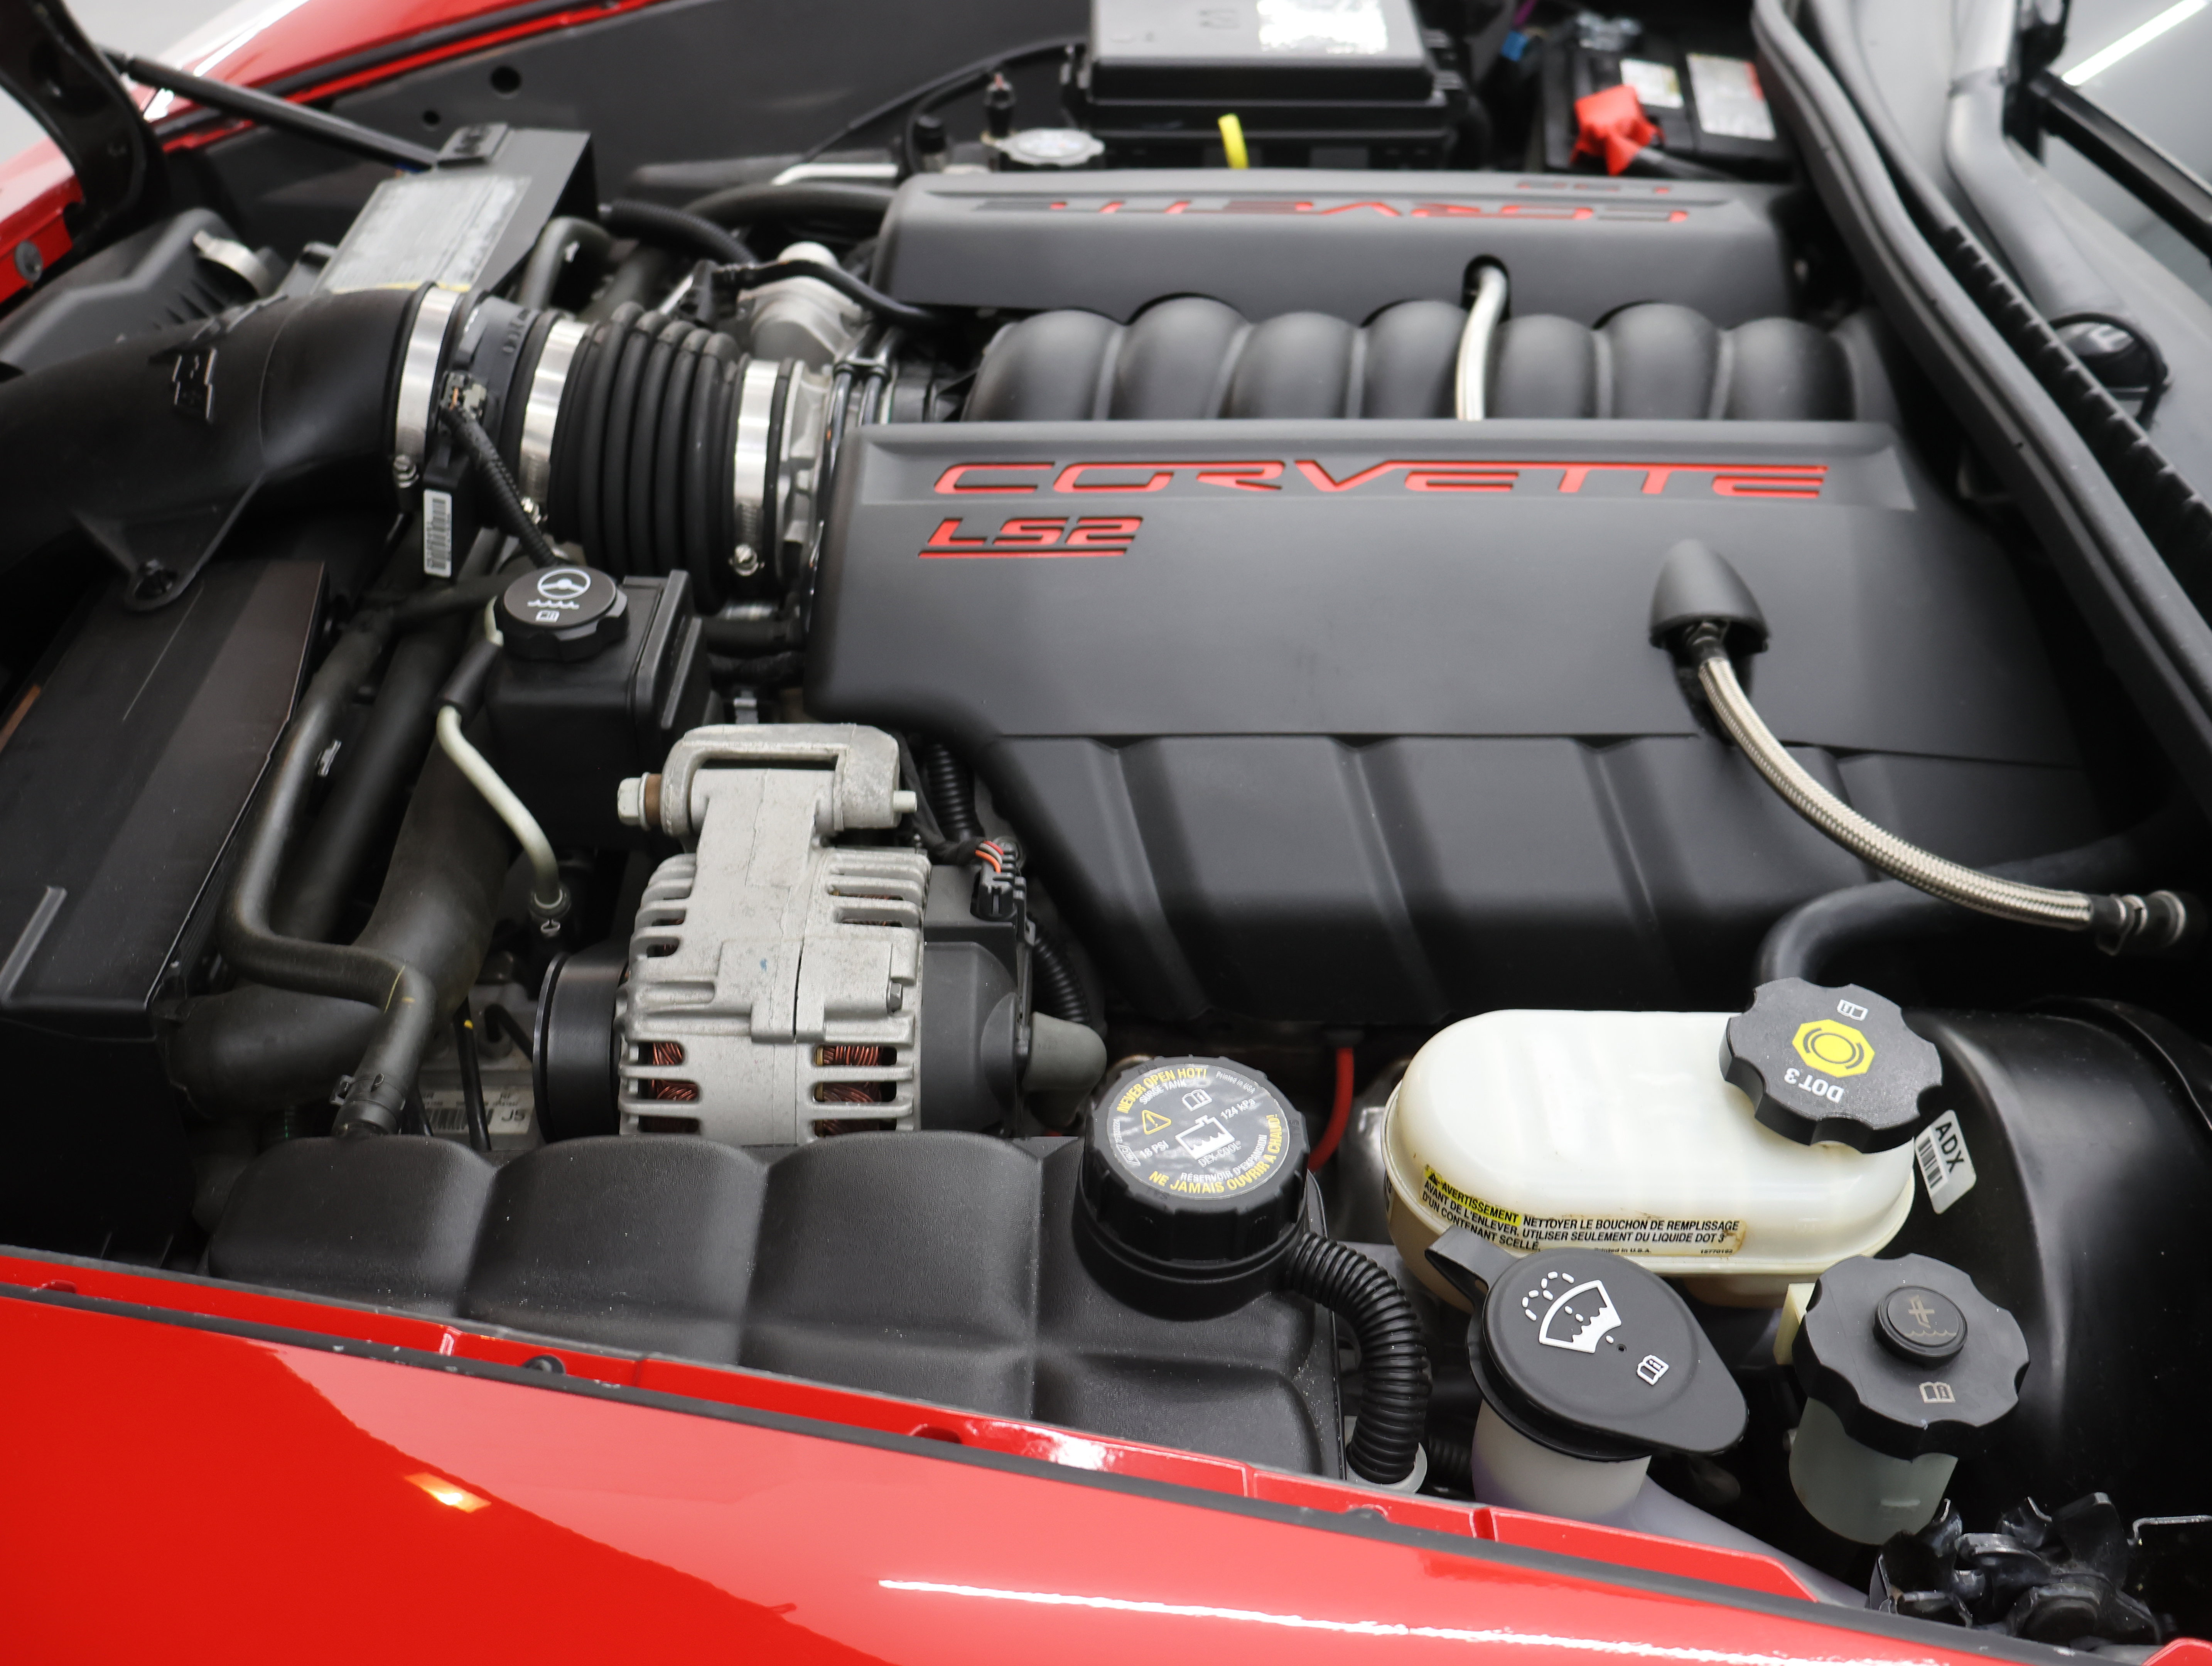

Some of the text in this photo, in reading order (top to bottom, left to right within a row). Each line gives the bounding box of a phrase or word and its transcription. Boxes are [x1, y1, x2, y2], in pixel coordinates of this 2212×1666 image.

[933, 460, 1827, 498] CORVETTE
[928, 516, 1144, 546] LS2
[1117, 1084, 1147, 1114] NEVER
[1143, 1069, 1176, 1088] OPEN
[1177, 1067, 1207, 1079] HOT!
[1139, 1079, 1187, 1105] SURGE TANK
[1216, 1071, 1256, 1094] Printed in USA
[1784, 1067, 1844, 1103] DOT 3
[1220, 1098, 1256, 1120] 124 kPa
[1140, 1140, 1169, 1159] 18 PSI
[1149, 1171, 1170, 1187] NE
[1170, 1179, 1225, 1194] JAMAIS
[1226, 1161, 1271, 1191] OUVRIR
[1265, 1114, 1282, 1154] CHAUD!
[1180, 1134, 1267, 1183] RÉSERVOIR D'EXPANSION
[1935, 1121, 1964, 1173] ADX
[1422, 1190, 1440, 1212] D'UN
[1441, 1207, 1498, 1241] CONTENANT
[1424, 1180, 1449, 1205] AVANT
[1450, 1200, 1462, 1214] DE
[1522, 1228, 1569, 1241] UTILISER
[1571, 1231, 1634, 1241] SEULEMENT
[1635, 1232, 1650, 1242] DU
[1652, 1232, 1694, 1243] LIQUIDE
[1694, 1233, 1718, 1243] DOT
[1718, 1232, 1725, 1244] 3
[1441, 1182, 1740, 1231] AVERTISSEMENT NETTOYER LE BOUCHON DE REMPLISSAGE
